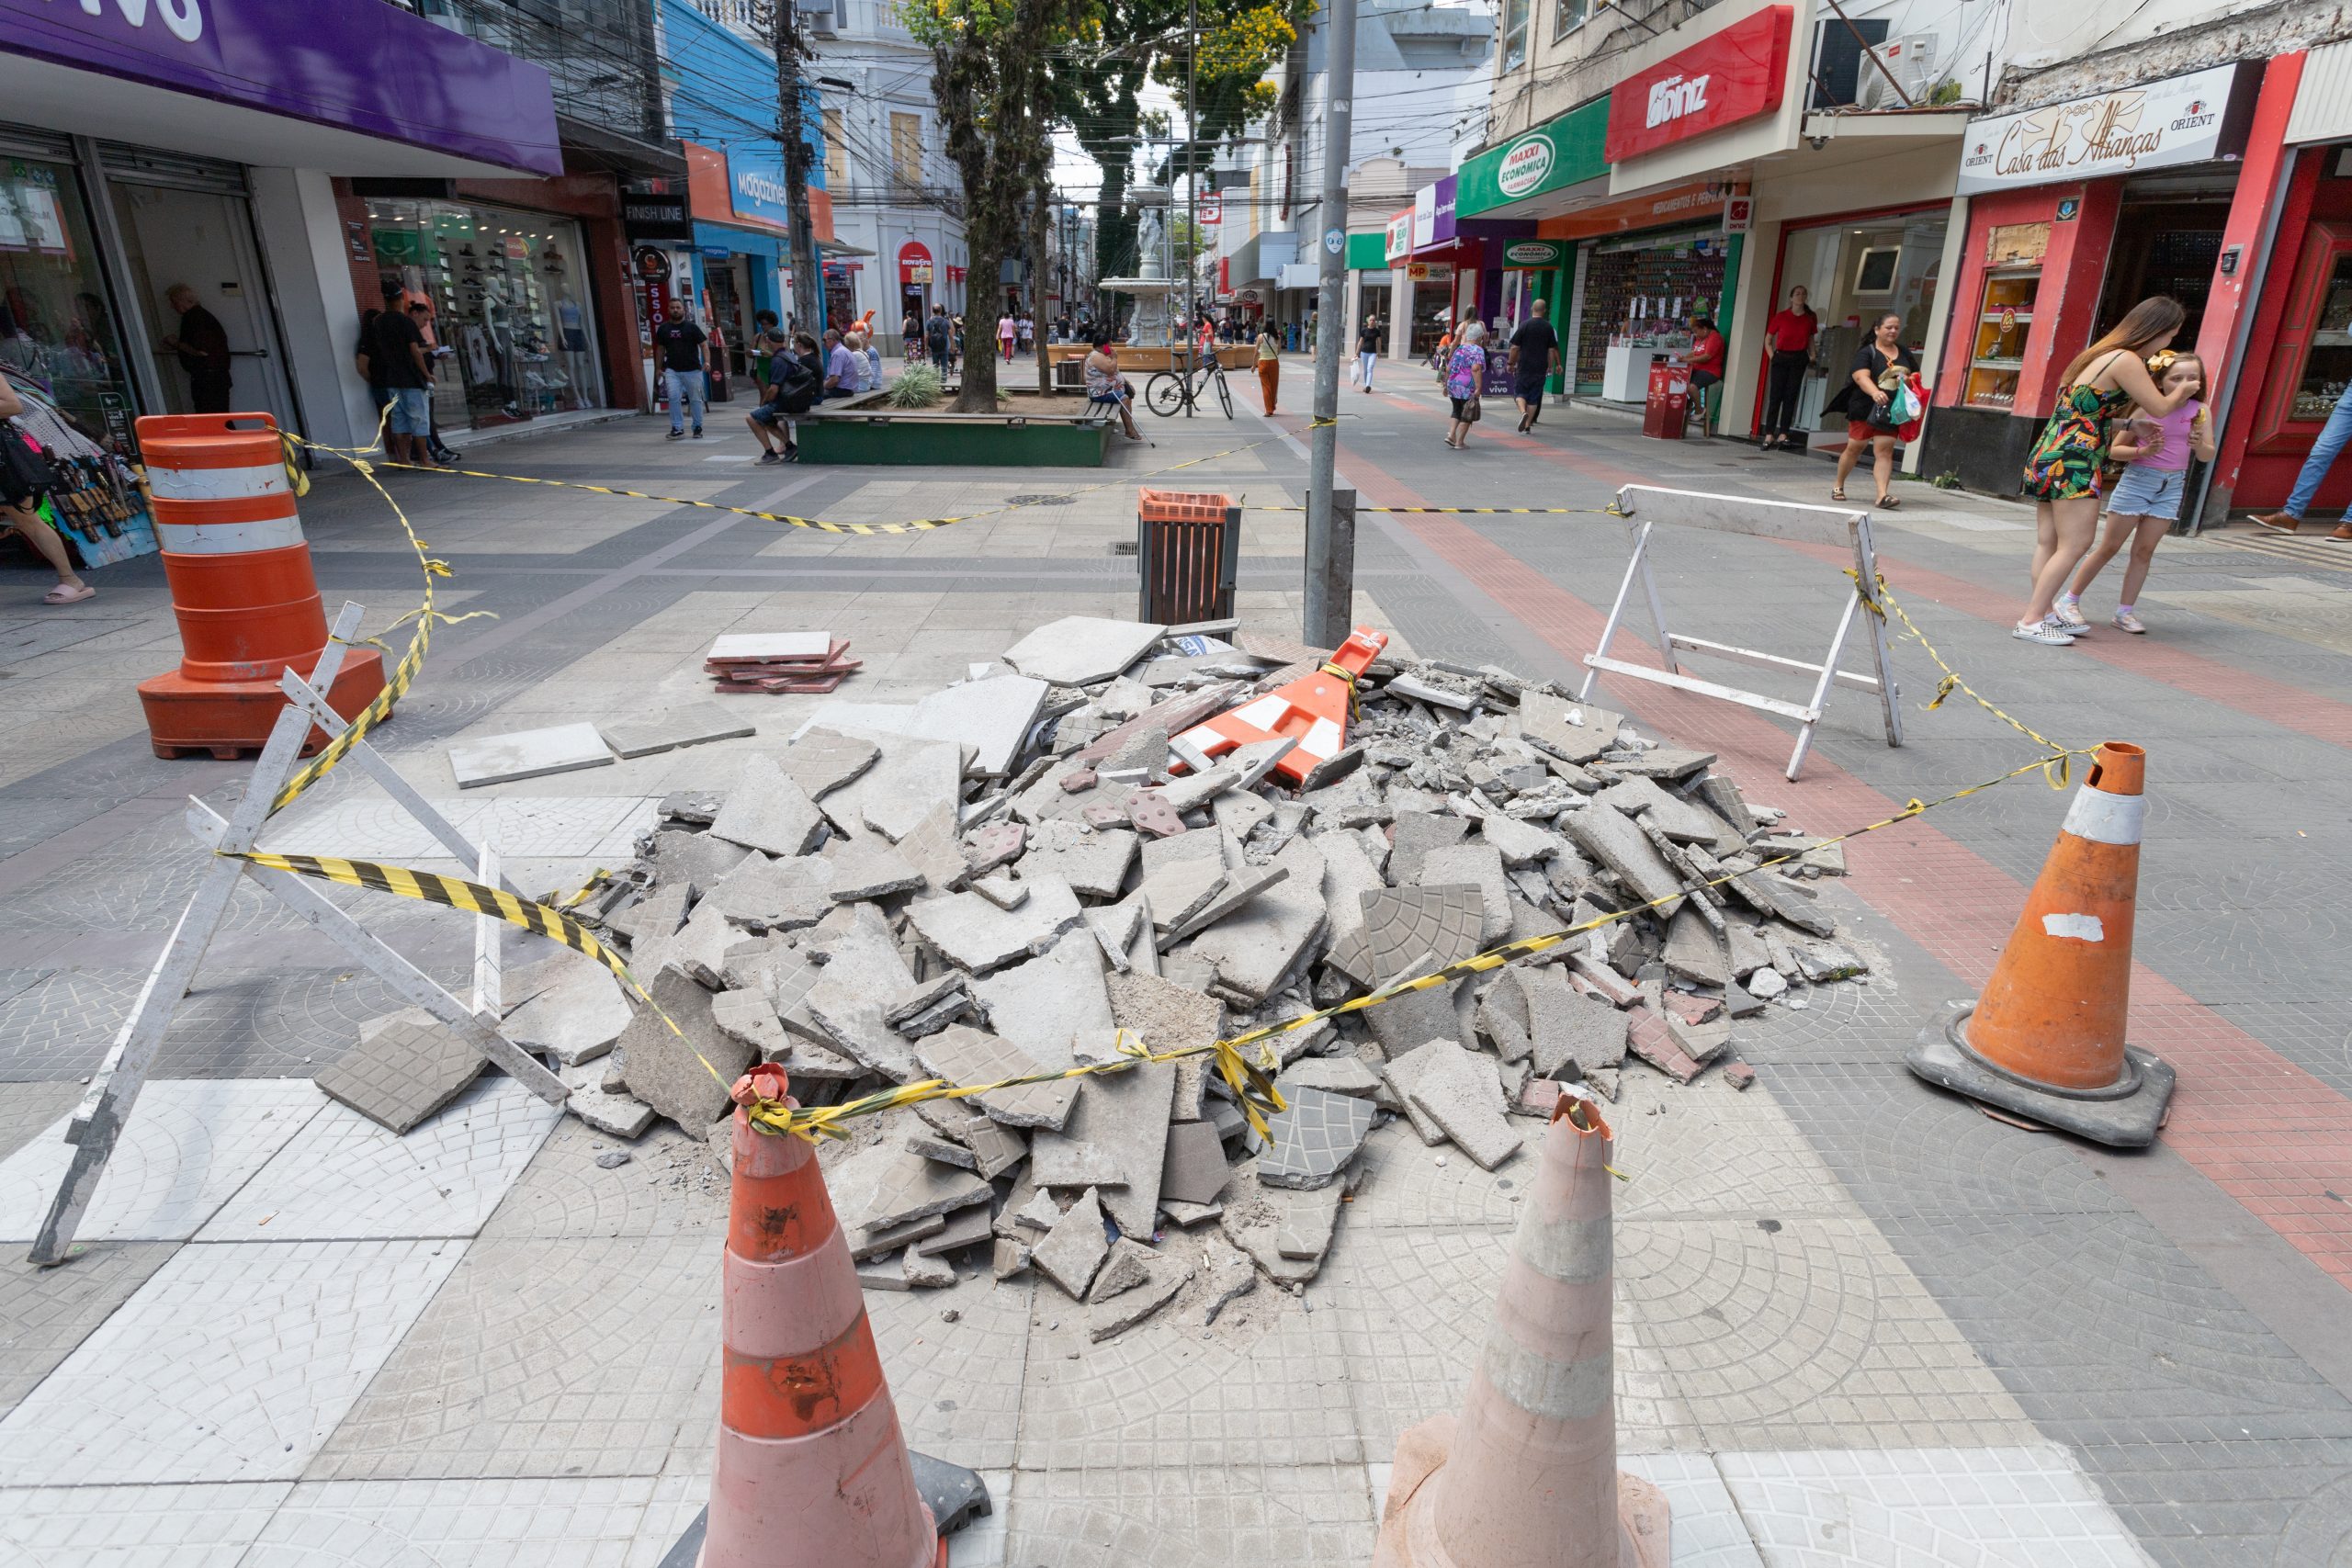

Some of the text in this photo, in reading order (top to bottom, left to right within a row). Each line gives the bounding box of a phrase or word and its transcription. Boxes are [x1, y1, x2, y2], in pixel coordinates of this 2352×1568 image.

[2171, 113, 2215, 130] ORIENT
[1996, 99, 2164, 175] Casa das Alianças
[1509, 143, 1540, 166] MAXXI
[1965, 153, 1994, 167] ORIENT
[626, 205, 683, 220] FINISH LINE
[1408, 267, 1425, 277] MP
[1488, 385, 1509, 393] vivo
